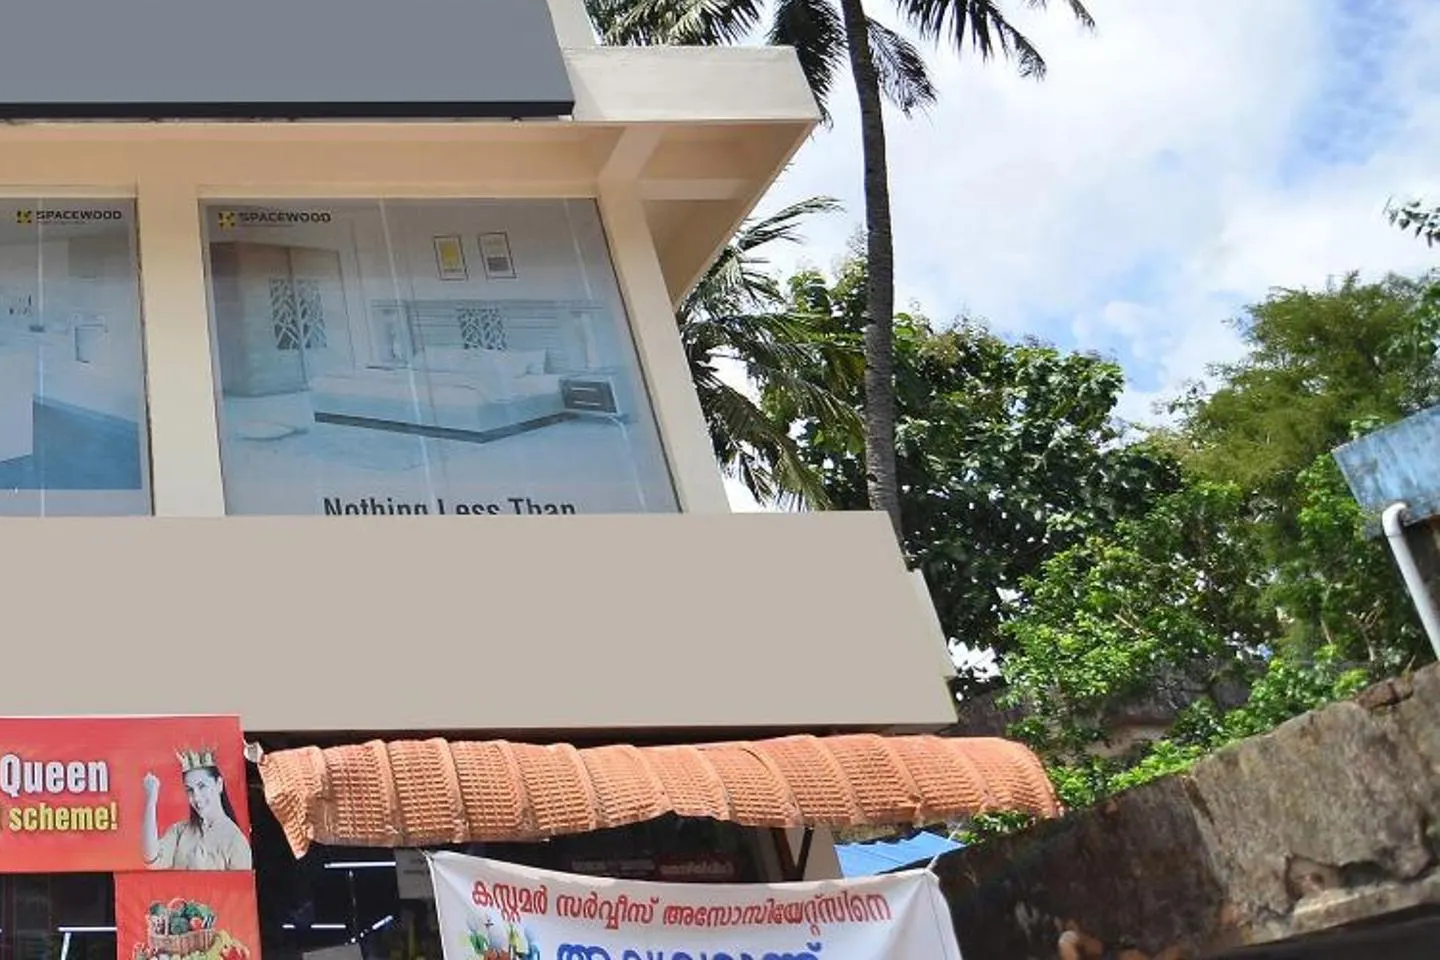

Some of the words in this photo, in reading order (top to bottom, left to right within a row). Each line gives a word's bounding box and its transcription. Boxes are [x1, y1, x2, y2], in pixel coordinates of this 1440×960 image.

[36, 210, 122, 220] SPACEWOOD
[238, 211, 331, 224] SPACEWOOD
[8, 801, 118, 832] scheme!
